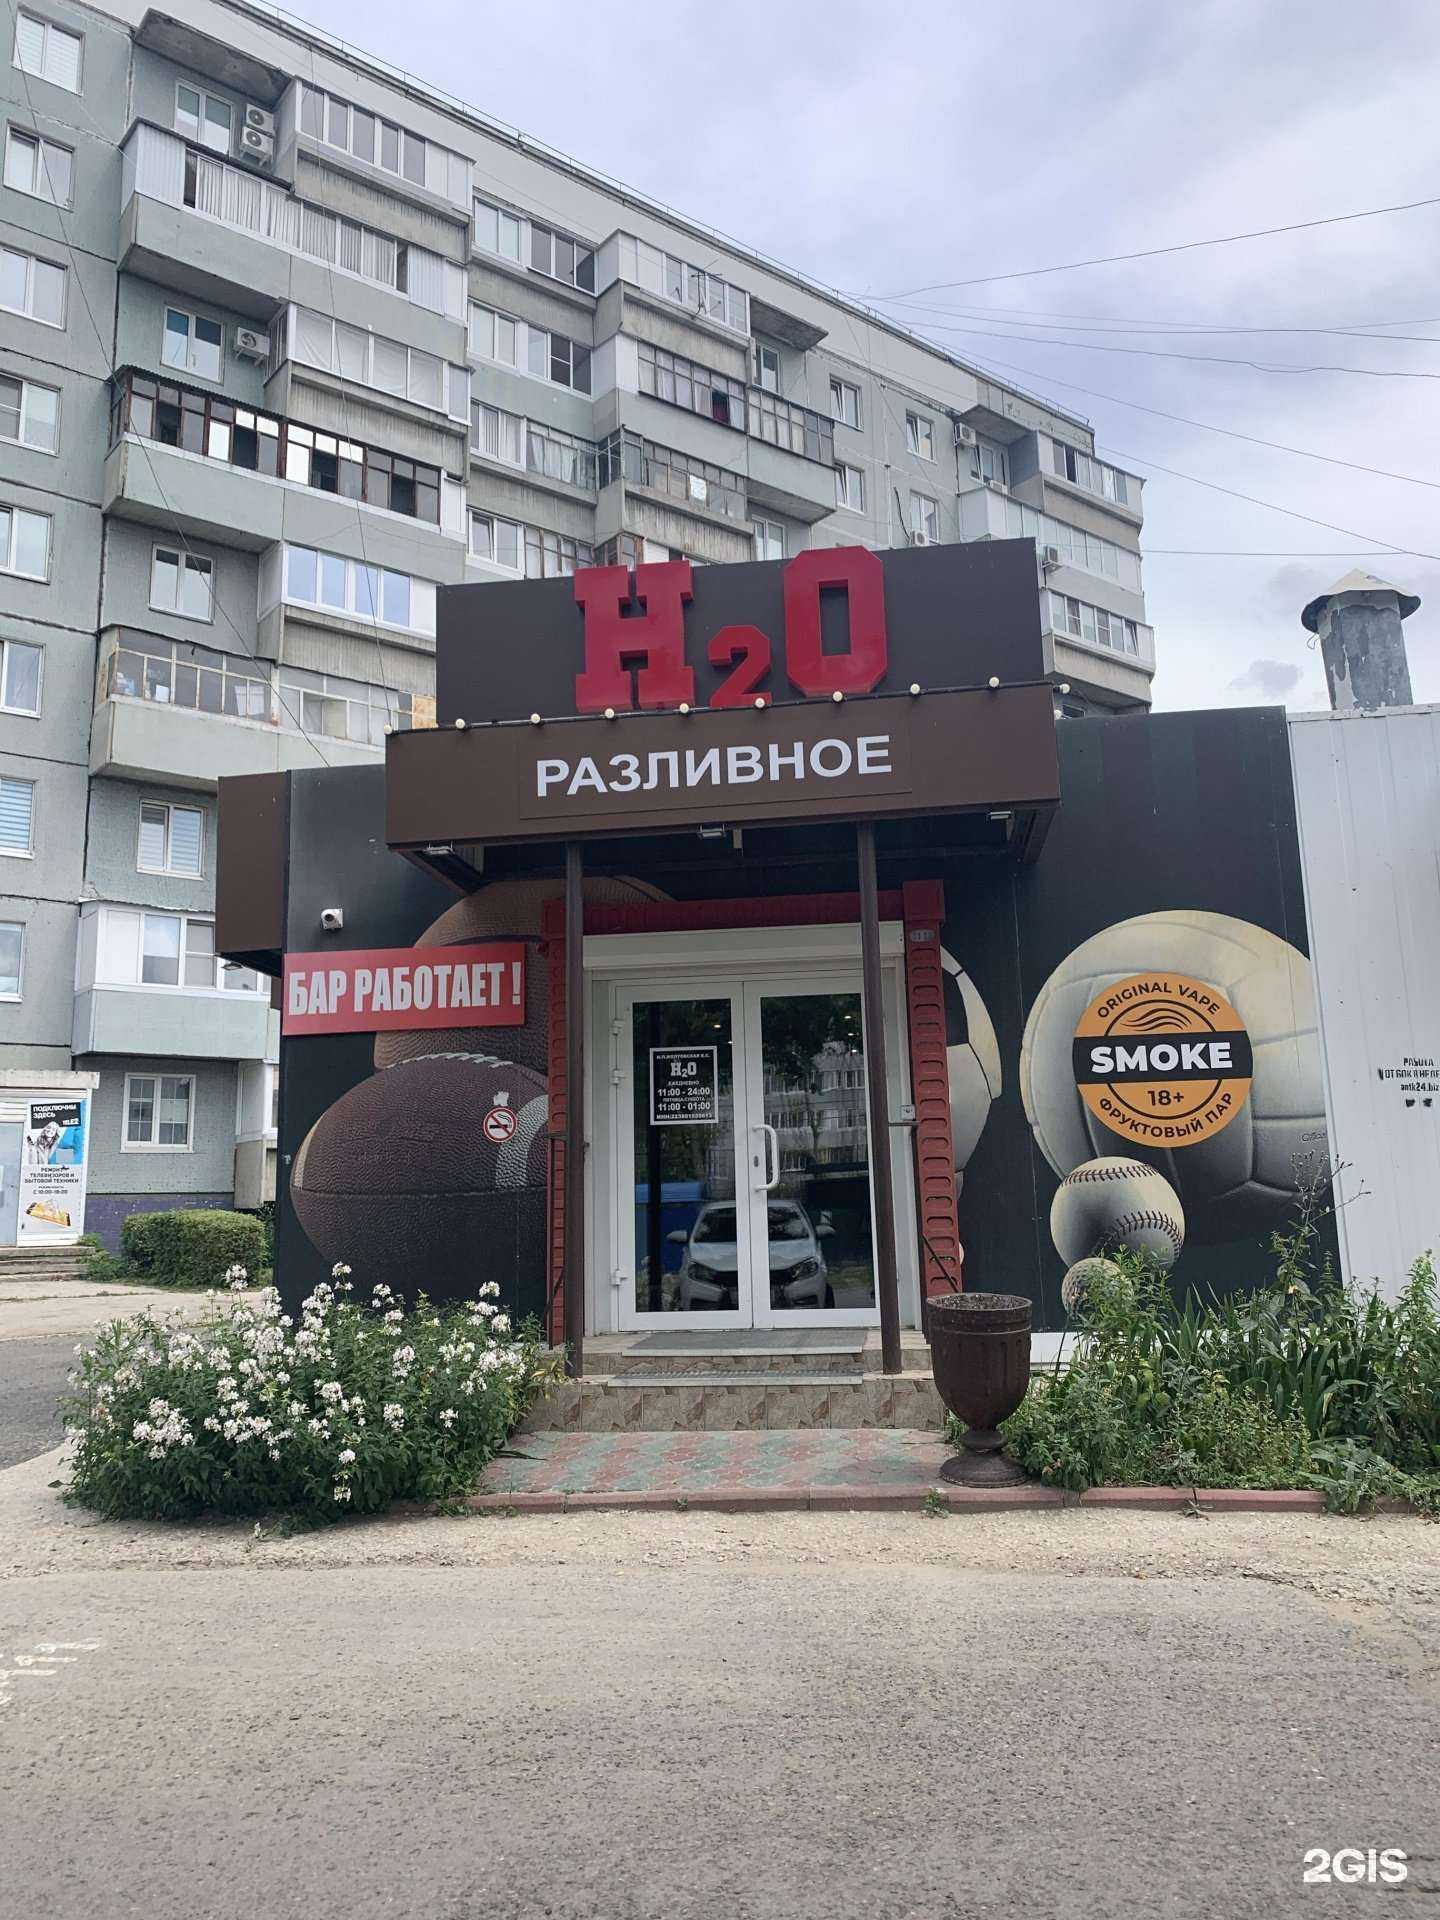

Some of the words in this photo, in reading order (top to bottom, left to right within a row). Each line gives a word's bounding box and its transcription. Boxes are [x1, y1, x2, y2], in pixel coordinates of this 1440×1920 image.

[536, 735, 893, 797] РАЗЛИВНОЕ
[288, 970, 347, 1016] БАР
[1097, 982, 1173, 1018] ORIGINAL
[1178, 984, 1221, 1015] VAPE
[1090, 1041, 1233, 1074] SMOKE
[658, 1088, 681, 1097] 11:00
[687, 1087, 711, 1096] 24:00
[658, 1103, 681, 1111] 11:00
[687, 1102, 711, 1110] 01:00
[1147, 1090, 1184, 1106] 18+
[1099, 1098, 1204, 1138] ФРУКТОВЫЙ
[1204, 1092, 1233, 1124] ПАР
